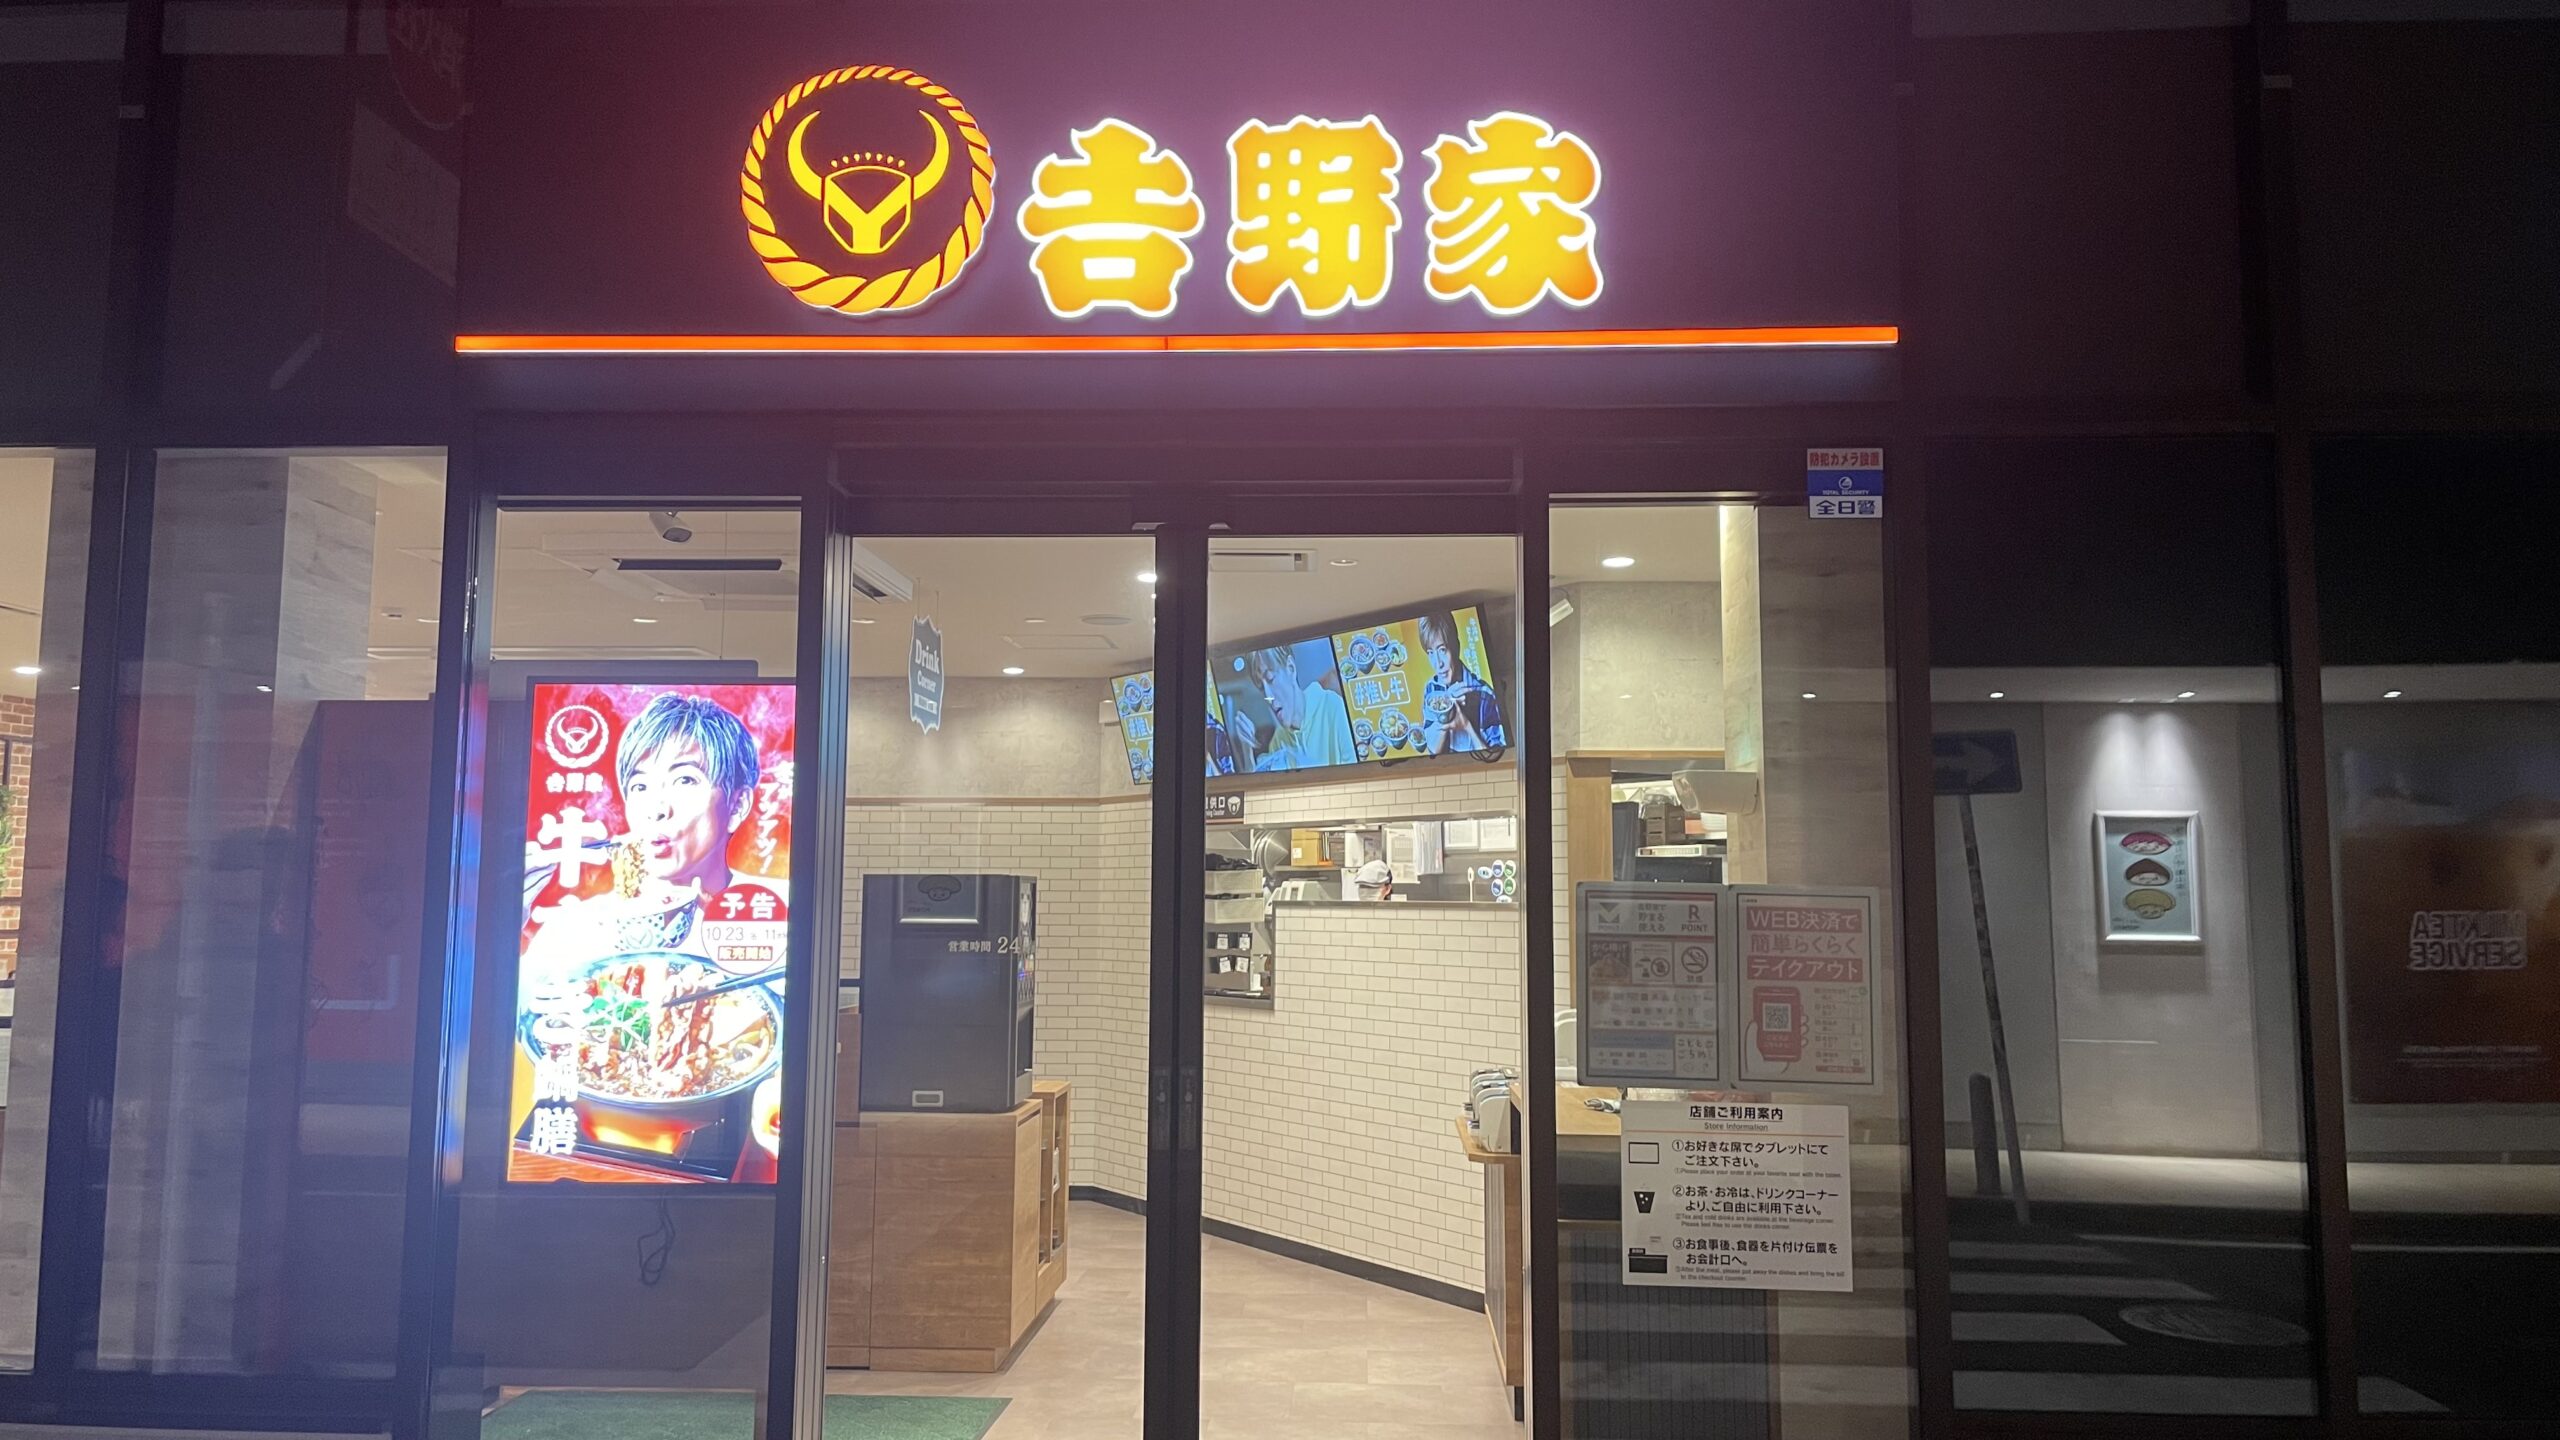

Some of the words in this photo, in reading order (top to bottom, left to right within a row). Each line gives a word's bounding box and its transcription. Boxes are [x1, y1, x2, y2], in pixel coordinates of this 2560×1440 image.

[1018, 111, 1603, 317] 吉野家
[1816, 500, 1876, 515] 全日警
[915, 639, 940, 675] Drink
[719, 892, 777, 920] 予告
[1681, 923, 1708, 932] POINT
[1750, 910, 1858, 930] WEB決済で
[1751, 934, 1856, 954] 簡単らくらく
[1751, 959, 1858, 980] テイクアウト
[1689, 1106, 1783, 1120] 店舗ご利用案内
[1704, 1122, 1724, 1130] Store
[1726, 1123, 1768, 1132] Information
[1685, 1155, 1759, 1168] ご注文下さい。
[1685, 1200, 1822, 1216] より、ご自由に利用下さい。
[1686, 1254, 1748, 1267] お会計口へ。
